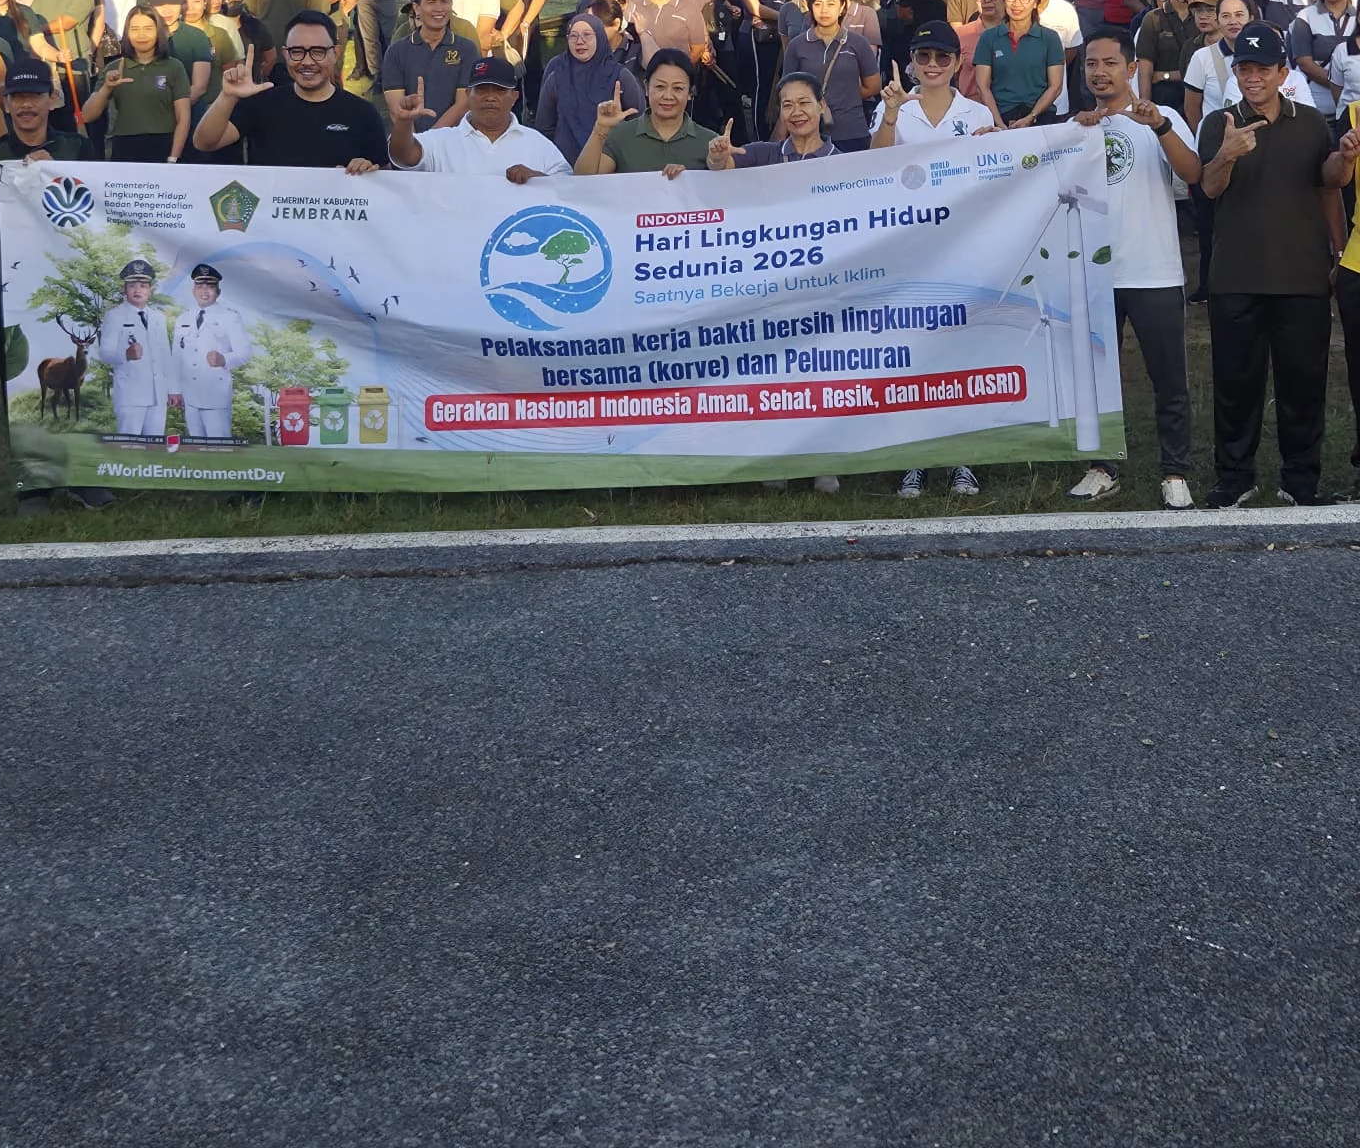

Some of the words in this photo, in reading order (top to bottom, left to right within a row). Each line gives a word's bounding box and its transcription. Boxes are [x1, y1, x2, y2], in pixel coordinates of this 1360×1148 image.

[930, 161, 950, 170] WORLD
[977, 153, 998, 167] UN
[931, 166, 970, 179] ENVIRONMENT
[104, 181, 160, 190] Kementerian
[811, 174, 894, 194] #NowForClimate
[931, 179, 942, 187] DAY
[104, 191, 155, 200] Lingkungan
[157, 193, 187, 201] Hidup/
[272, 196, 320, 205] PEMERINTAH
[323, 197, 369, 206] KABUPATEN
[104, 200, 131, 208] Badan
[134, 201, 193, 211] Pengendalian
[105, 209, 154, 219] Lingkungan
[156, 212, 183, 220] Hidup
[271, 207, 368, 221] JEMBRANA
[639, 211, 721, 227] INDONESIA
[143, 220, 186, 229] Indonesia
[635, 227, 690, 253] Hari
[700, 215, 858, 249] Lingkungan
[868, 203, 951, 229] Hidup
[634, 255, 743, 282] Sedunia
[753, 246, 824, 272] 2026
[634, 287, 705, 304] Saatnya
[711, 280, 779, 299] Bekerja
[785, 274, 839, 291] Untuk
[844, 266, 886, 283] Iklim
[481, 336, 626, 357] Pelaksanaan
[631, 328, 691, 352] kerja
[698, 318, 756, 347] bakti
[762, 311, 834, 341] bersih
[841, 303, 967, 335] lingkungan
[542, 364, 641, 387] bersama
[648, 351, 729, 385] (korve)
[736, 352, 778, 375] dan
[785, 345, 911, 374] Peluncuran
[432, 399, 510, 423] Gerakan
[515, 396, 595, 421] Nasional
[600, 392, 691, 418] Indonesia
[697, 391, 754, 415] Aman,
[759, 387, 817, 412] Sehat,
[822, 384, 880, 409] Resik,
[884, 383, 920, 405] dan
[923, 379, 963, 402] Indah
[967, 371, 1020, 398] (ASRI)
[97, 463, 285, 484] #WorldEnvironmentDay
